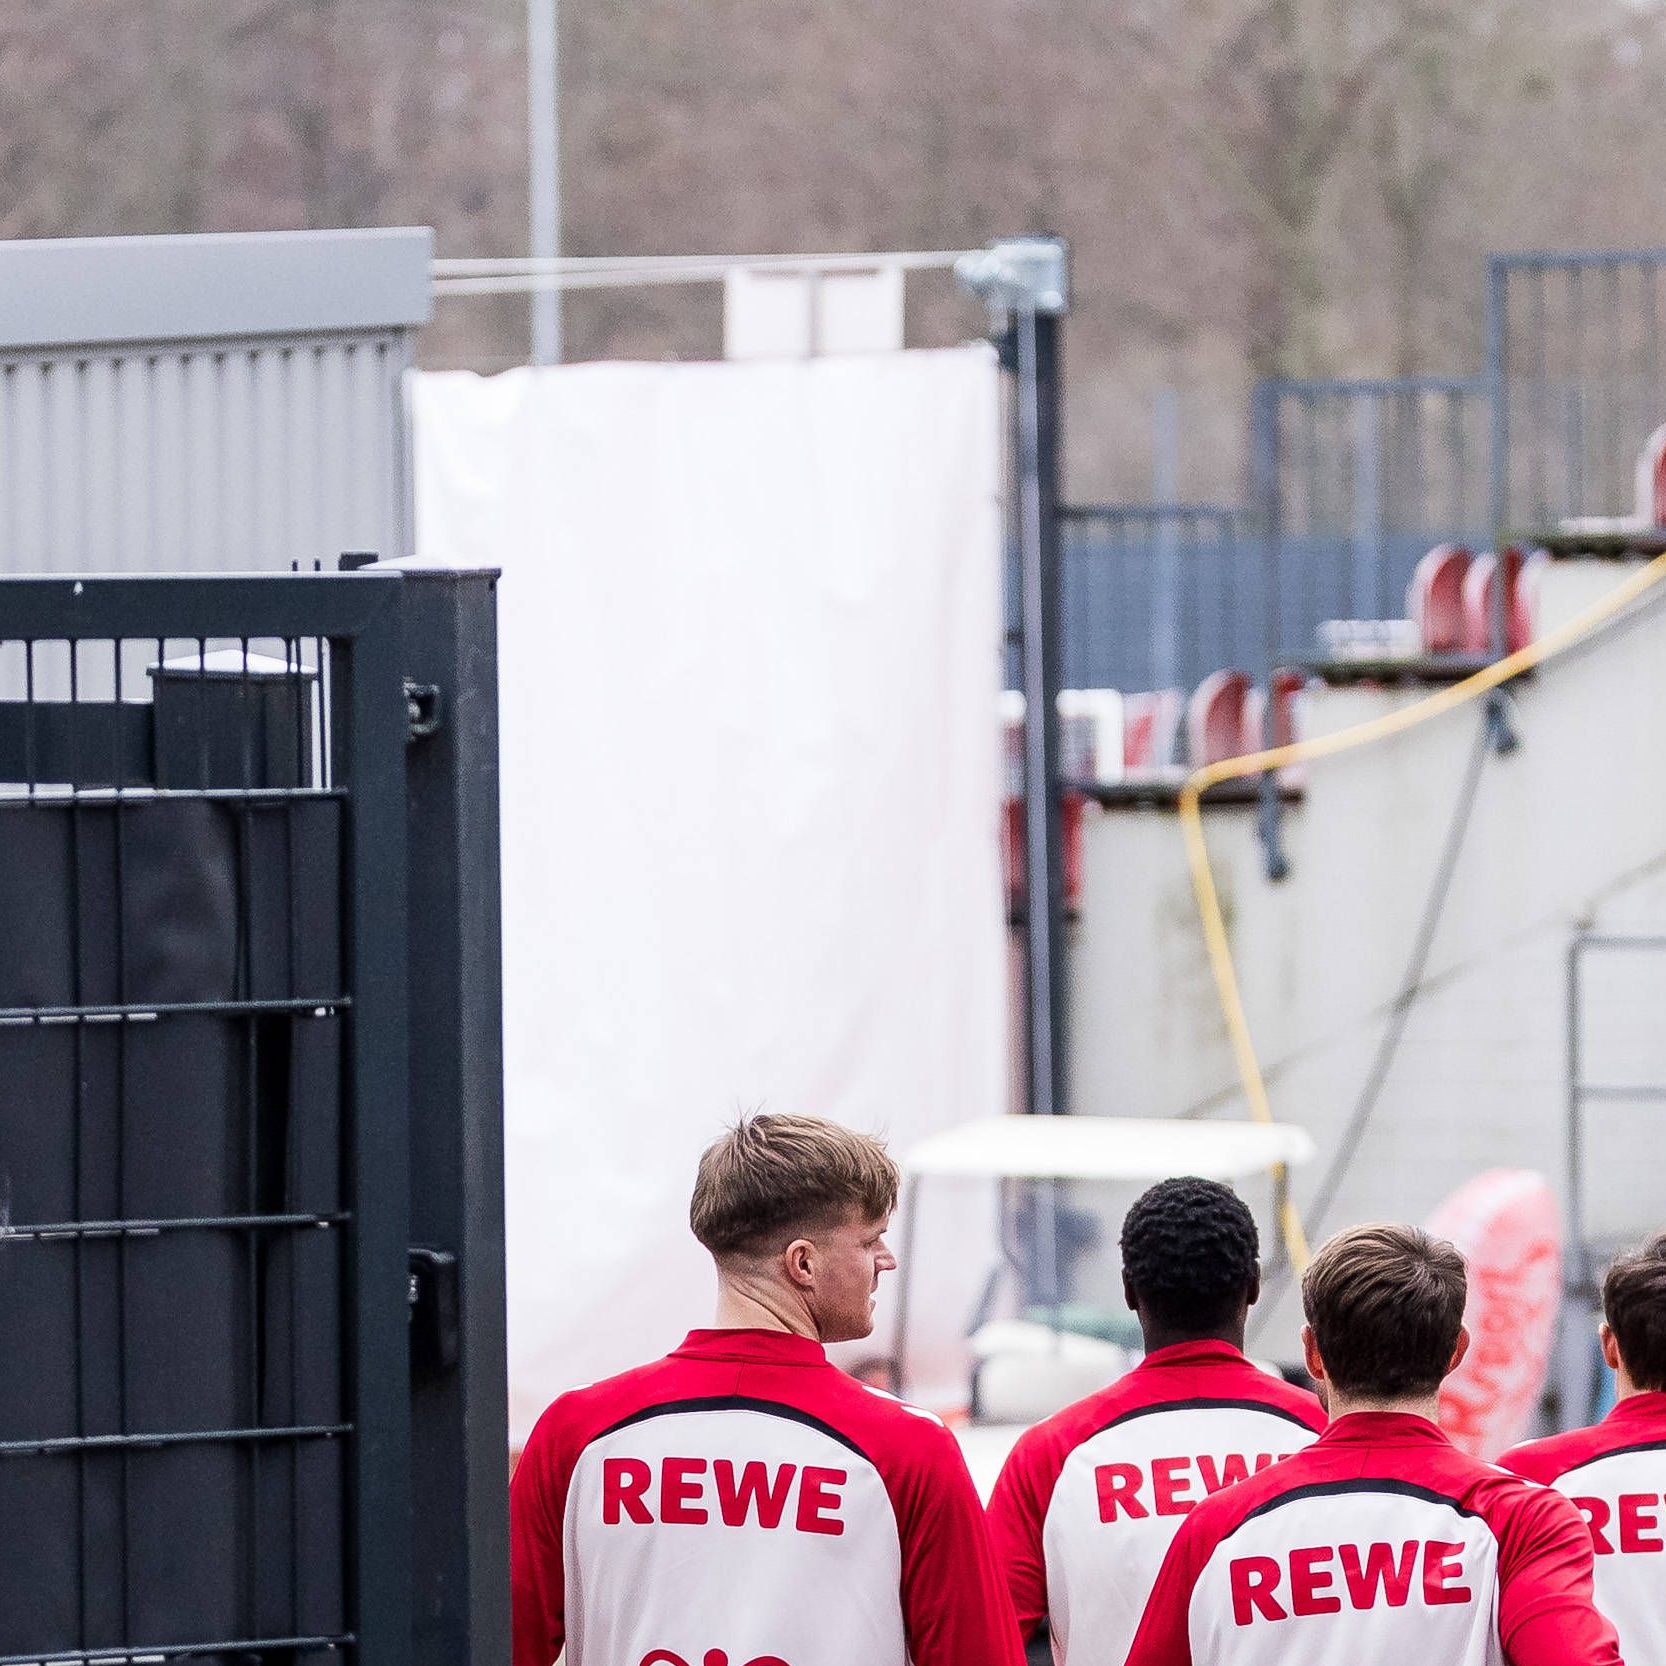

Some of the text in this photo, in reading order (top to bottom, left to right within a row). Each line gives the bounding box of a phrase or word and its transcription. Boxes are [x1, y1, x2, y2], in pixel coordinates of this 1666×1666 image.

[601, 1456, 849, 1536] REWE
[1094, 1453, 1297, 1524] REW
[1229, 1540, 1472, 1626] REWE
